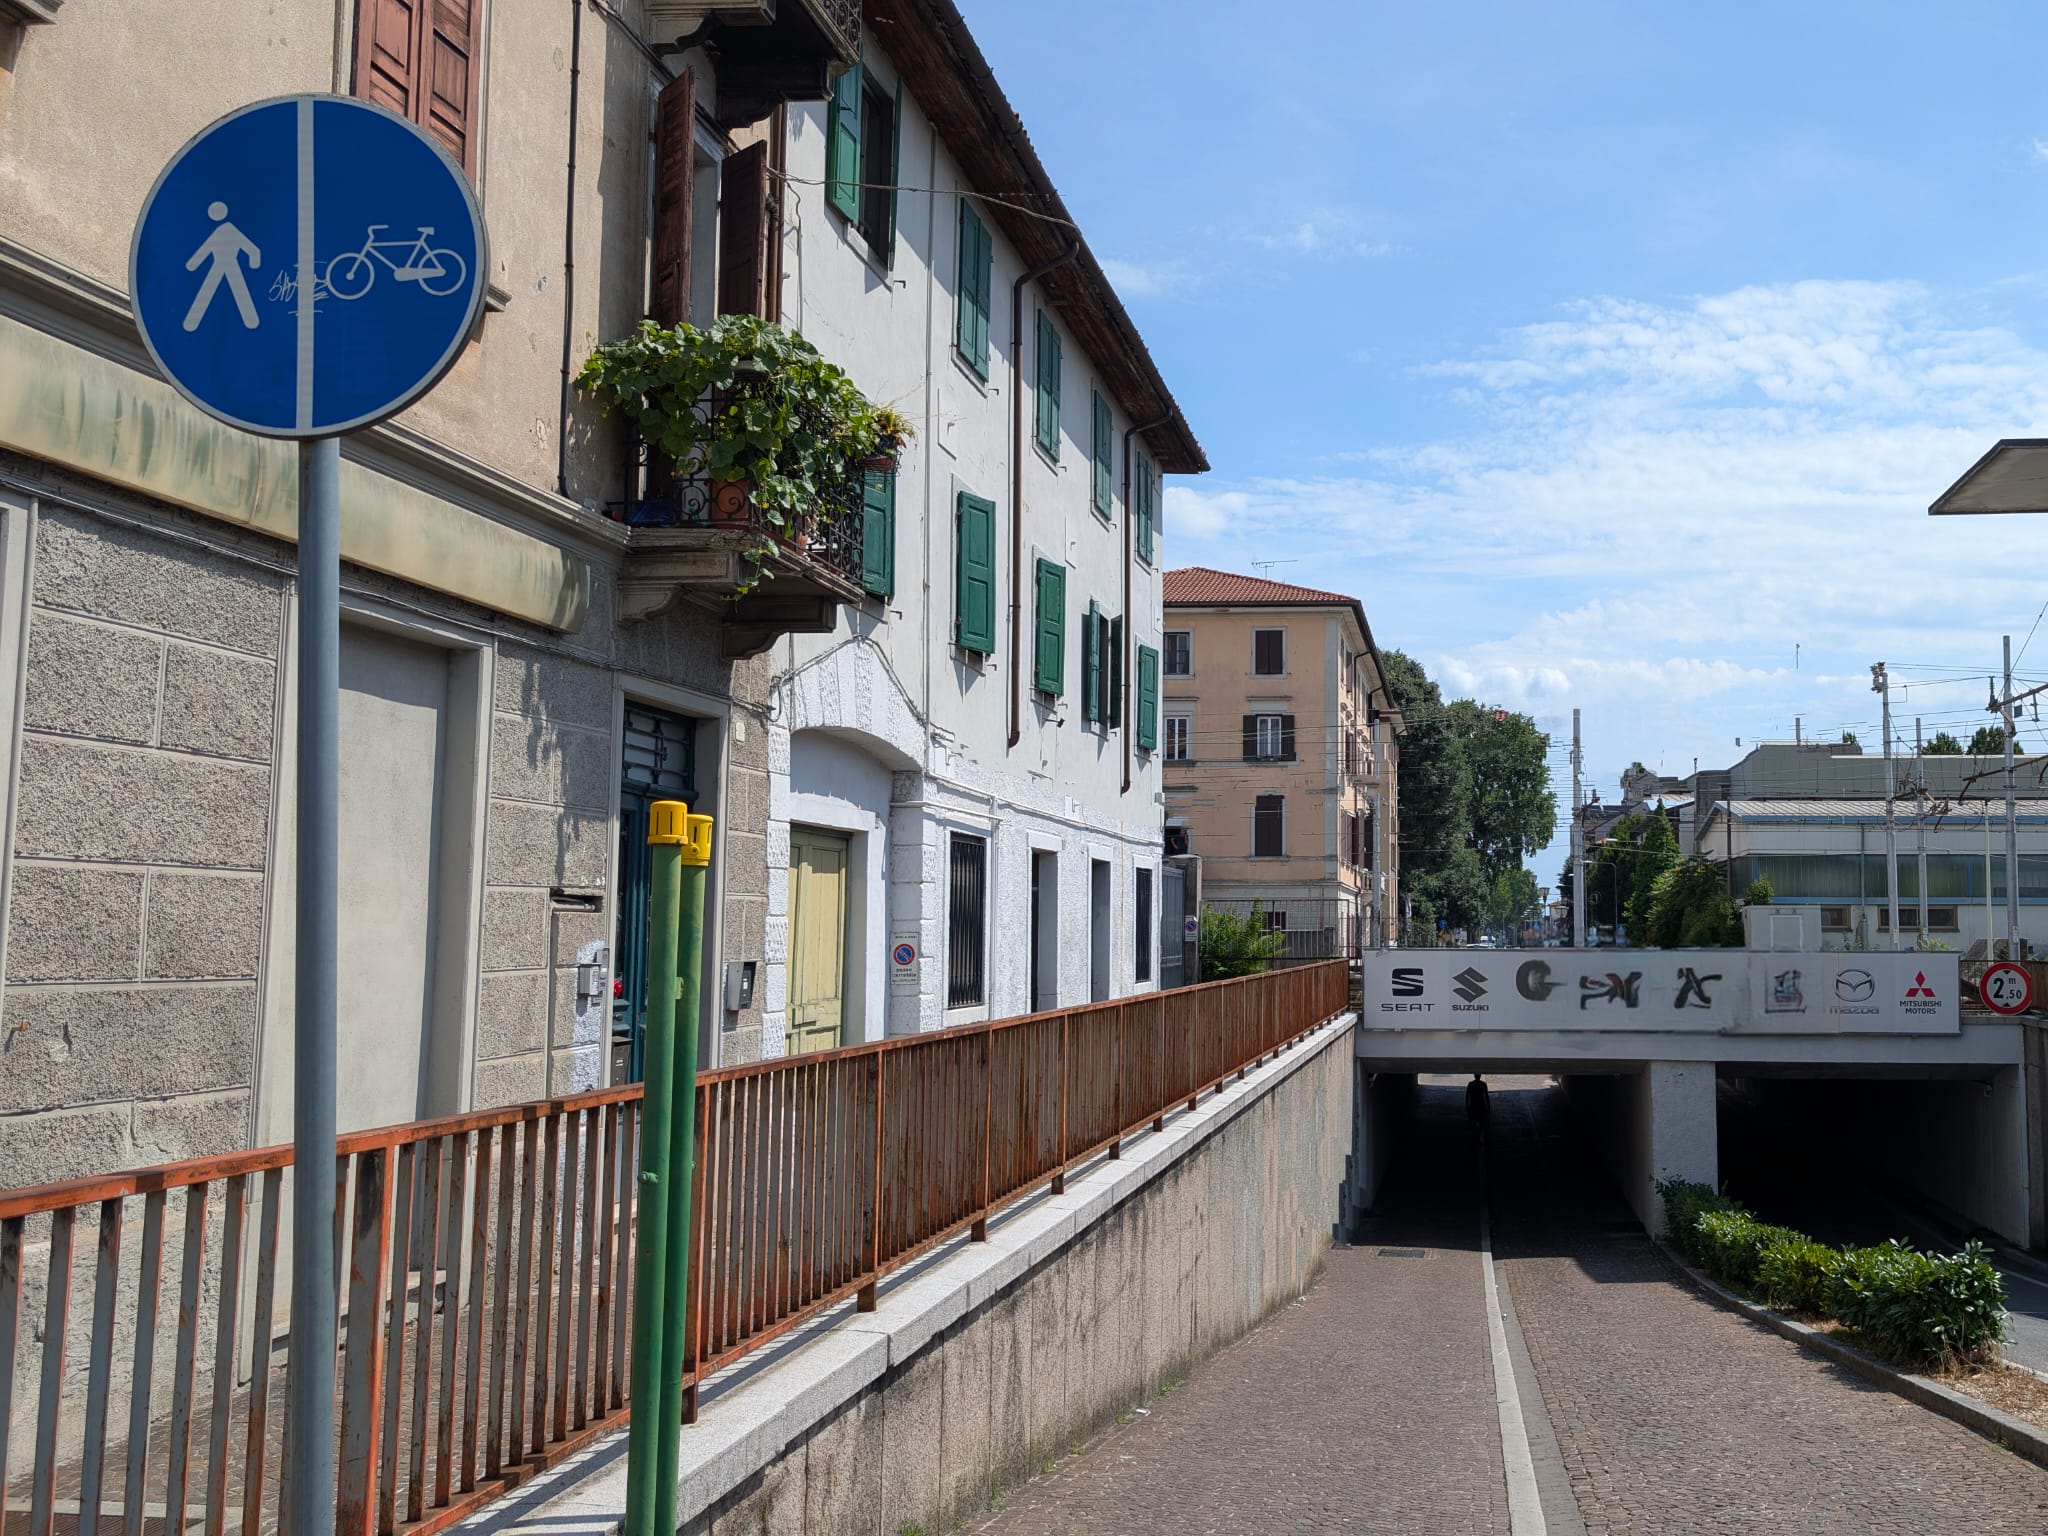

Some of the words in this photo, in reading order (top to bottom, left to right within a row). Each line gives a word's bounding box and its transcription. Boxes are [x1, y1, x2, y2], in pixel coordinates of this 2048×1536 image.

[1381, 1003, 1436, 1012] SEAT
[1451, 1004, 1489, 1012] SUZUKI
[1899, 1000, 1942, 1008] MITSUBISHI
